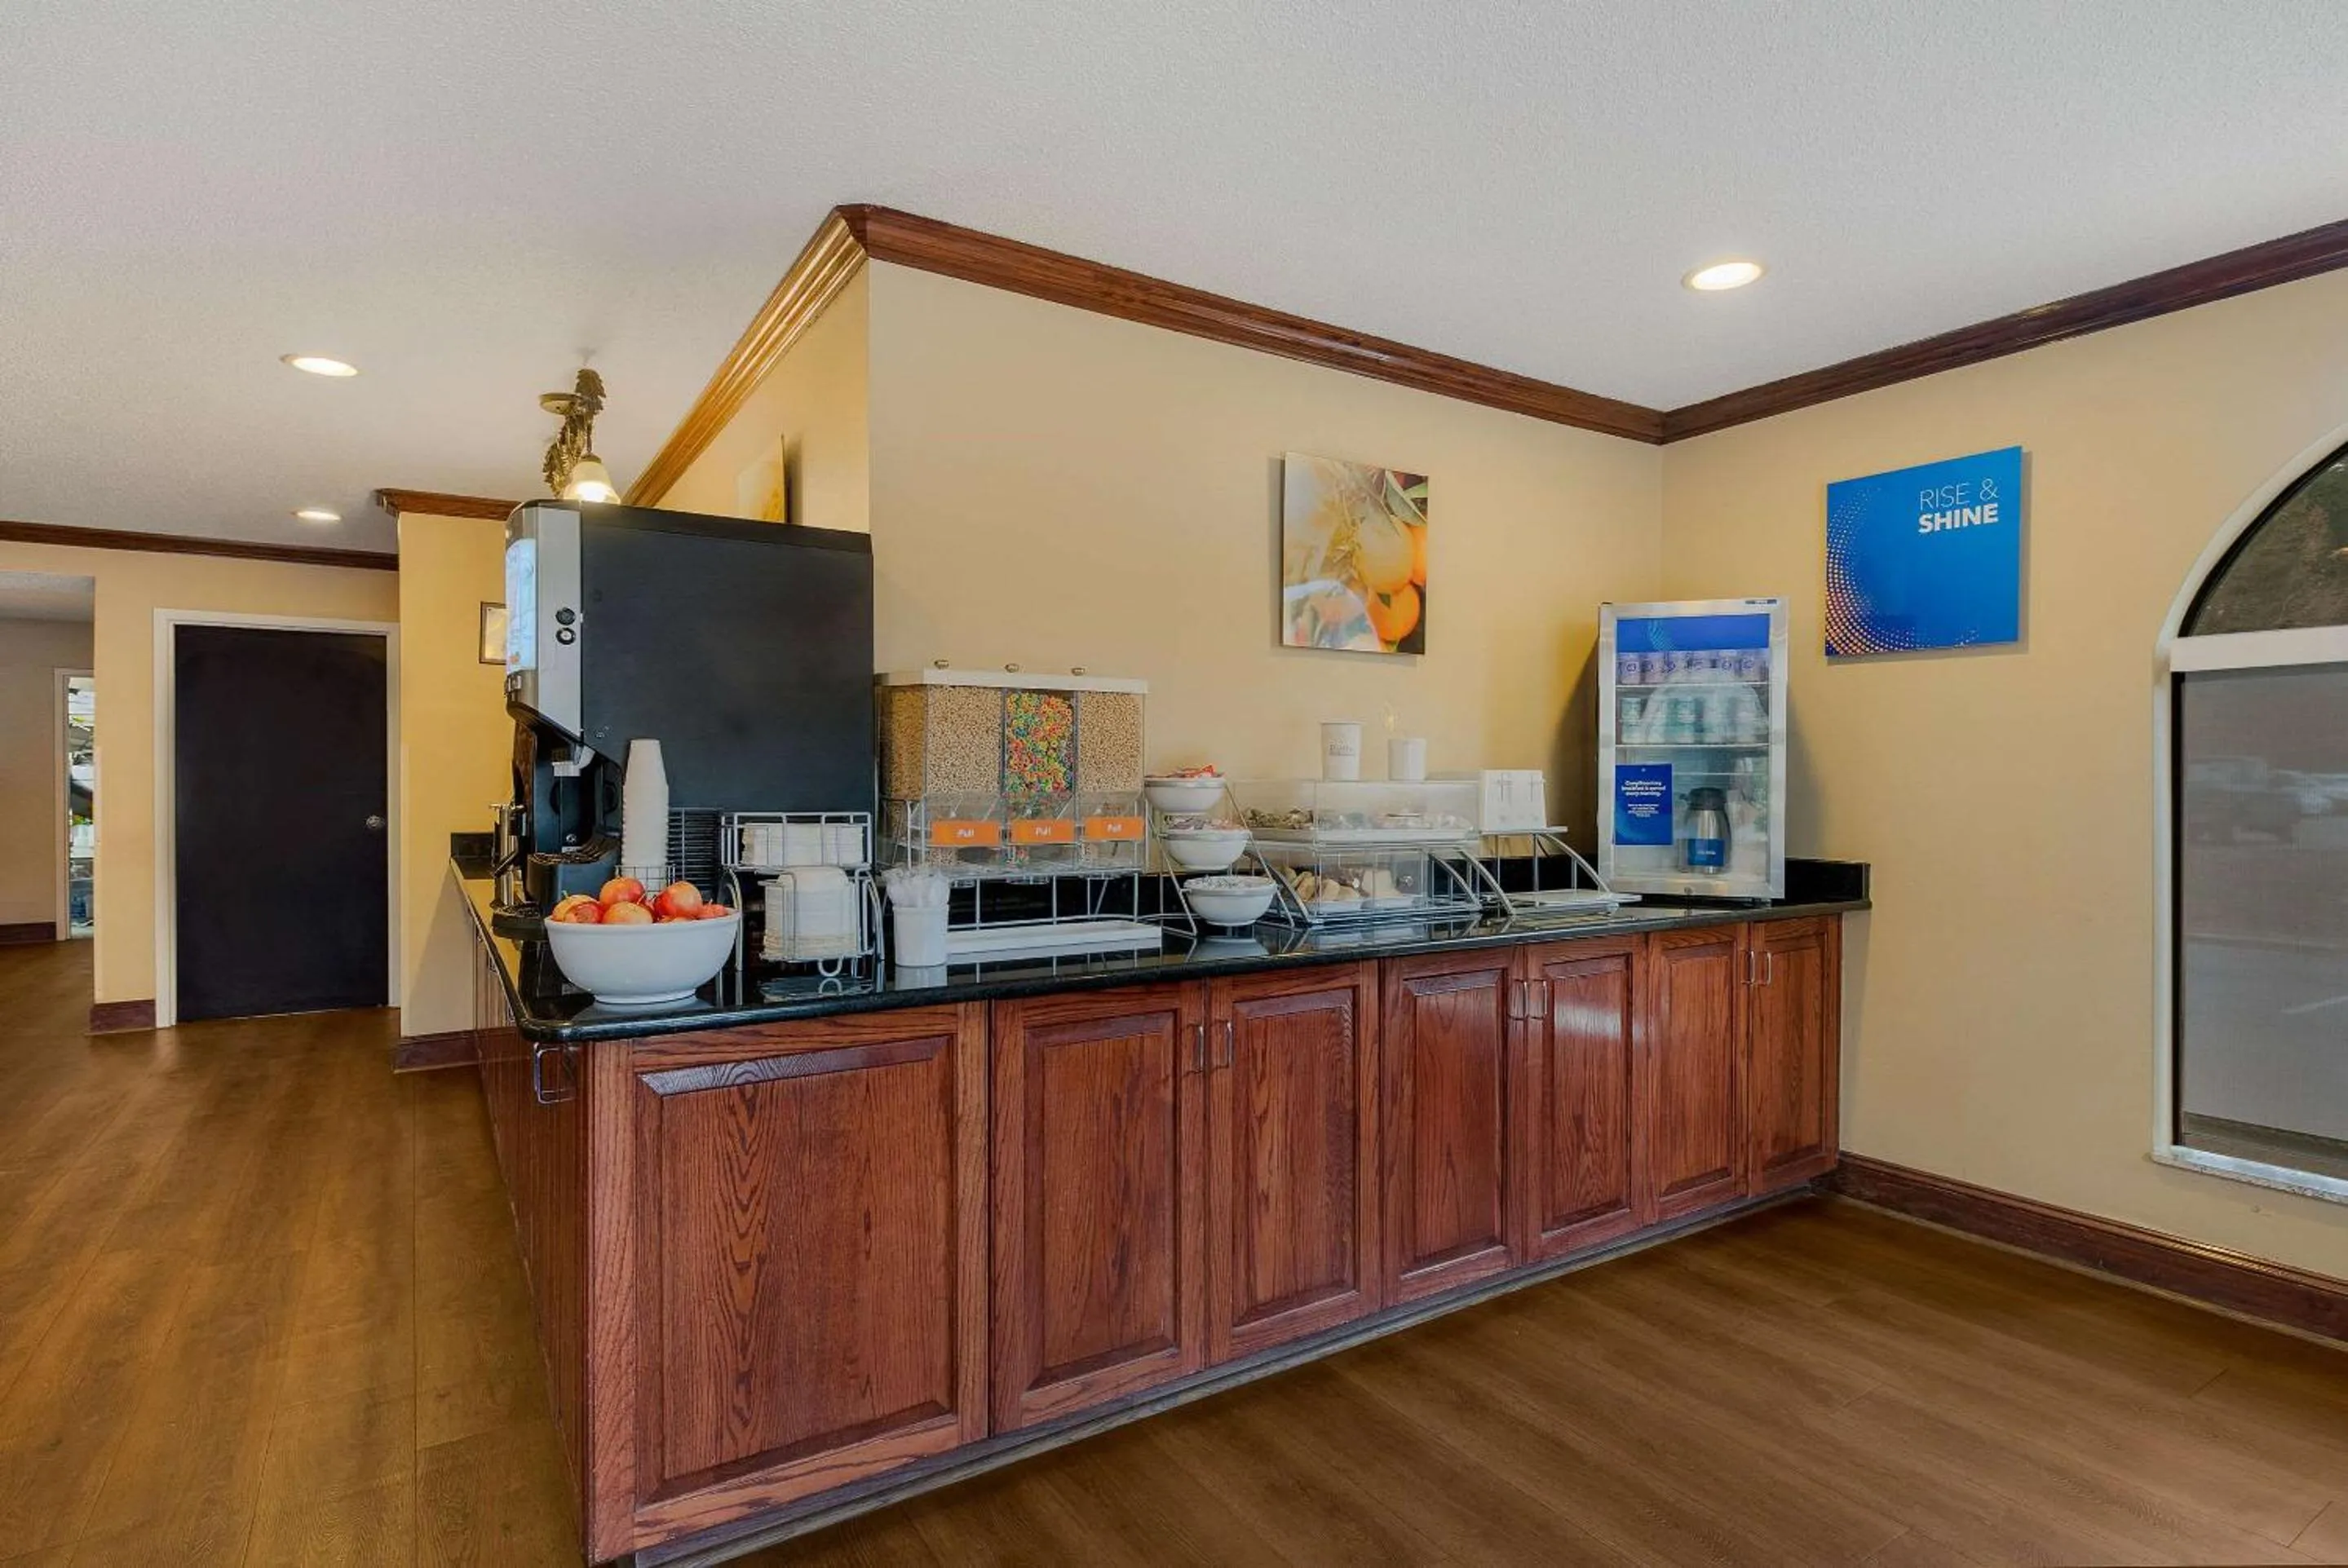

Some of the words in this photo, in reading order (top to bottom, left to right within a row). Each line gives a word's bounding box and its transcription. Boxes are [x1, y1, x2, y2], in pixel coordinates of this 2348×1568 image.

[1920, 483, 1970, 510] RISE
[1979, 478, 1999, 501] &
[1918, 503, 1999, 533] SHINE
[1036, 826, 1050, 837] Pull
